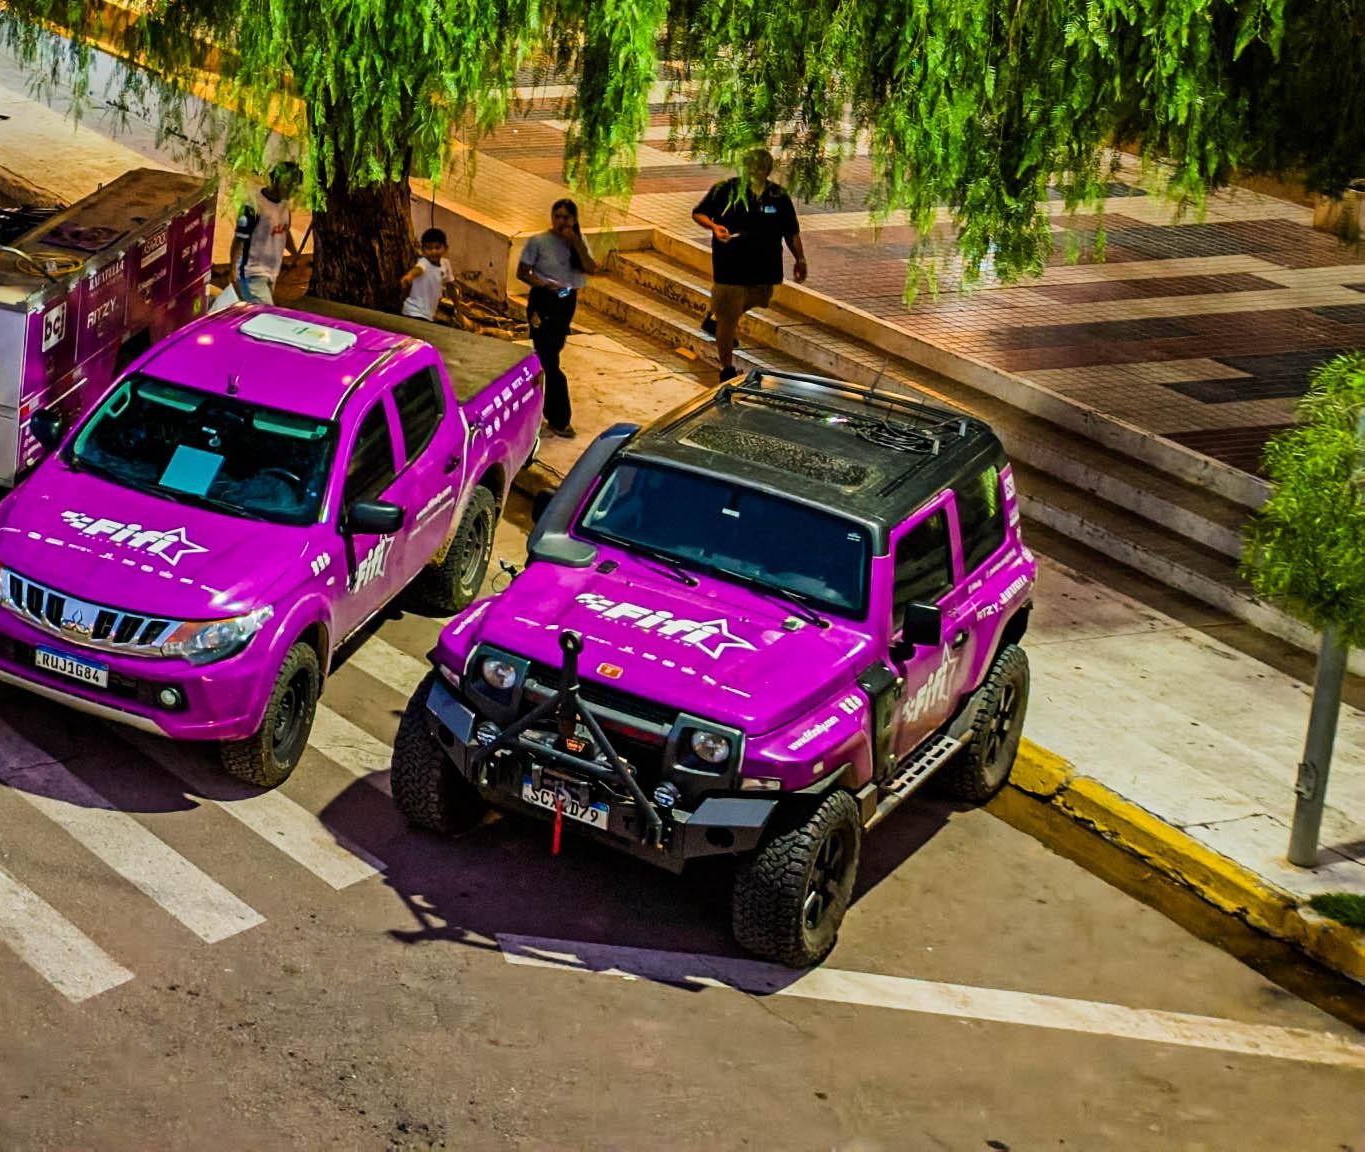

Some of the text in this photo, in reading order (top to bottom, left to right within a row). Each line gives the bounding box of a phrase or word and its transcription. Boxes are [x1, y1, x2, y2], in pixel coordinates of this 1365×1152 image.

[44, 303, 66, 341] bcj
[87, 296, 118, 329] RITZY
[82, 517, 179, 554] Fifi
[354, 538, 386, 594] Fifi
[601, 602, 719, 644] Fifi
[42, 655, 100, 683] RUJ1G84
[909, 662, 950, 722] Fifi
